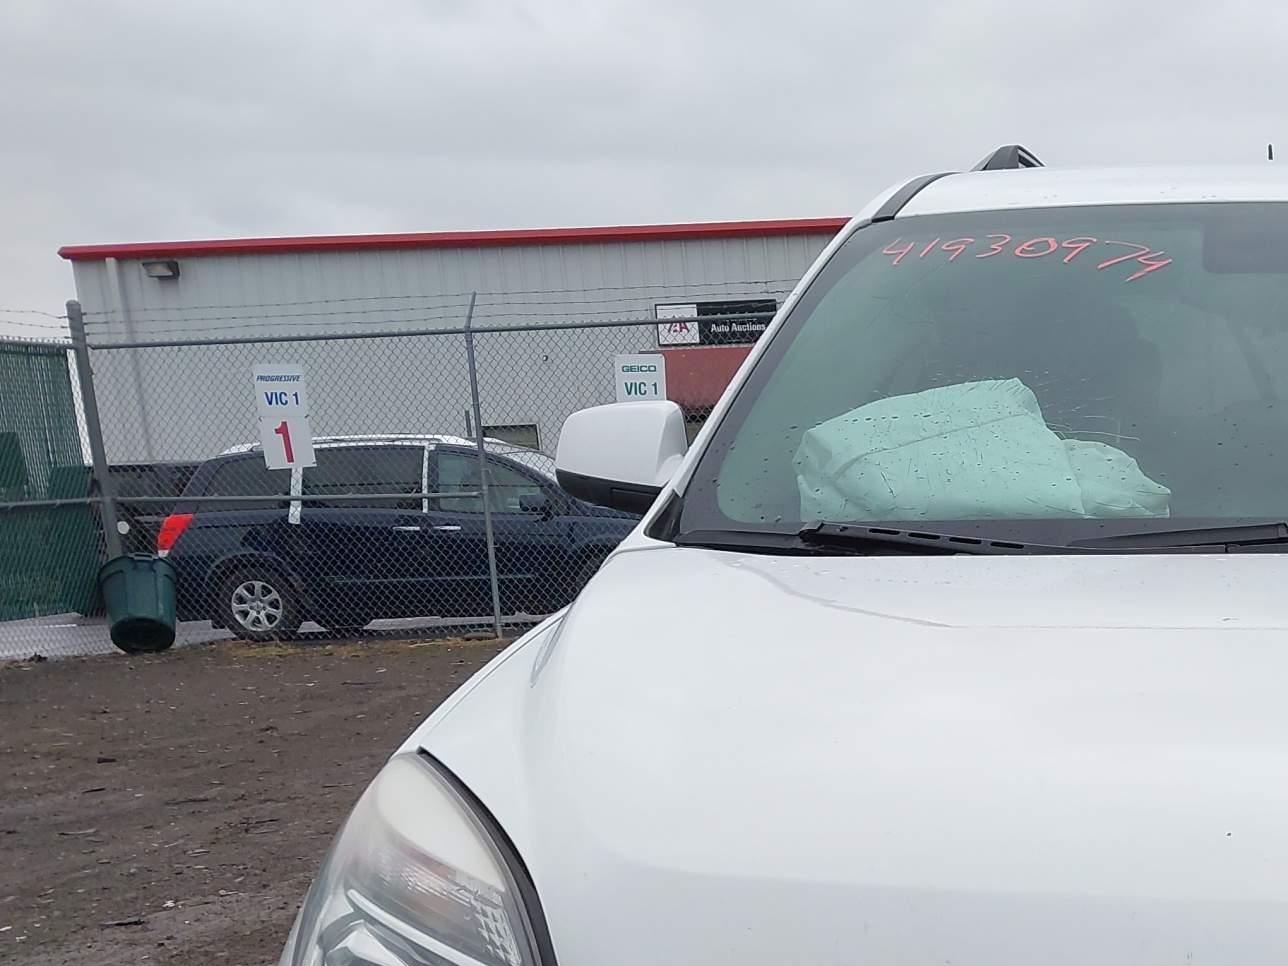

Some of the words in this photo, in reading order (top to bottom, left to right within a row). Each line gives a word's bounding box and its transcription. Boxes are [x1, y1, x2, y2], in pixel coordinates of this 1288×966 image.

[882, 234, 1173, 283] 41930974
[710, 323, 731, 333] Auto
[731, 321, 767, 333] Auctions
[621, 364, 657, 374] GEICO
[256, 374, 302, 383] PROGRESSIVE
[624, 381, 648, 396] VIC
[651, 381, 659, 396] 1
[264, 391, 289, 406] VIC
[292, 391, 300, 406] 1
[274, 420, 295, 464] 1
